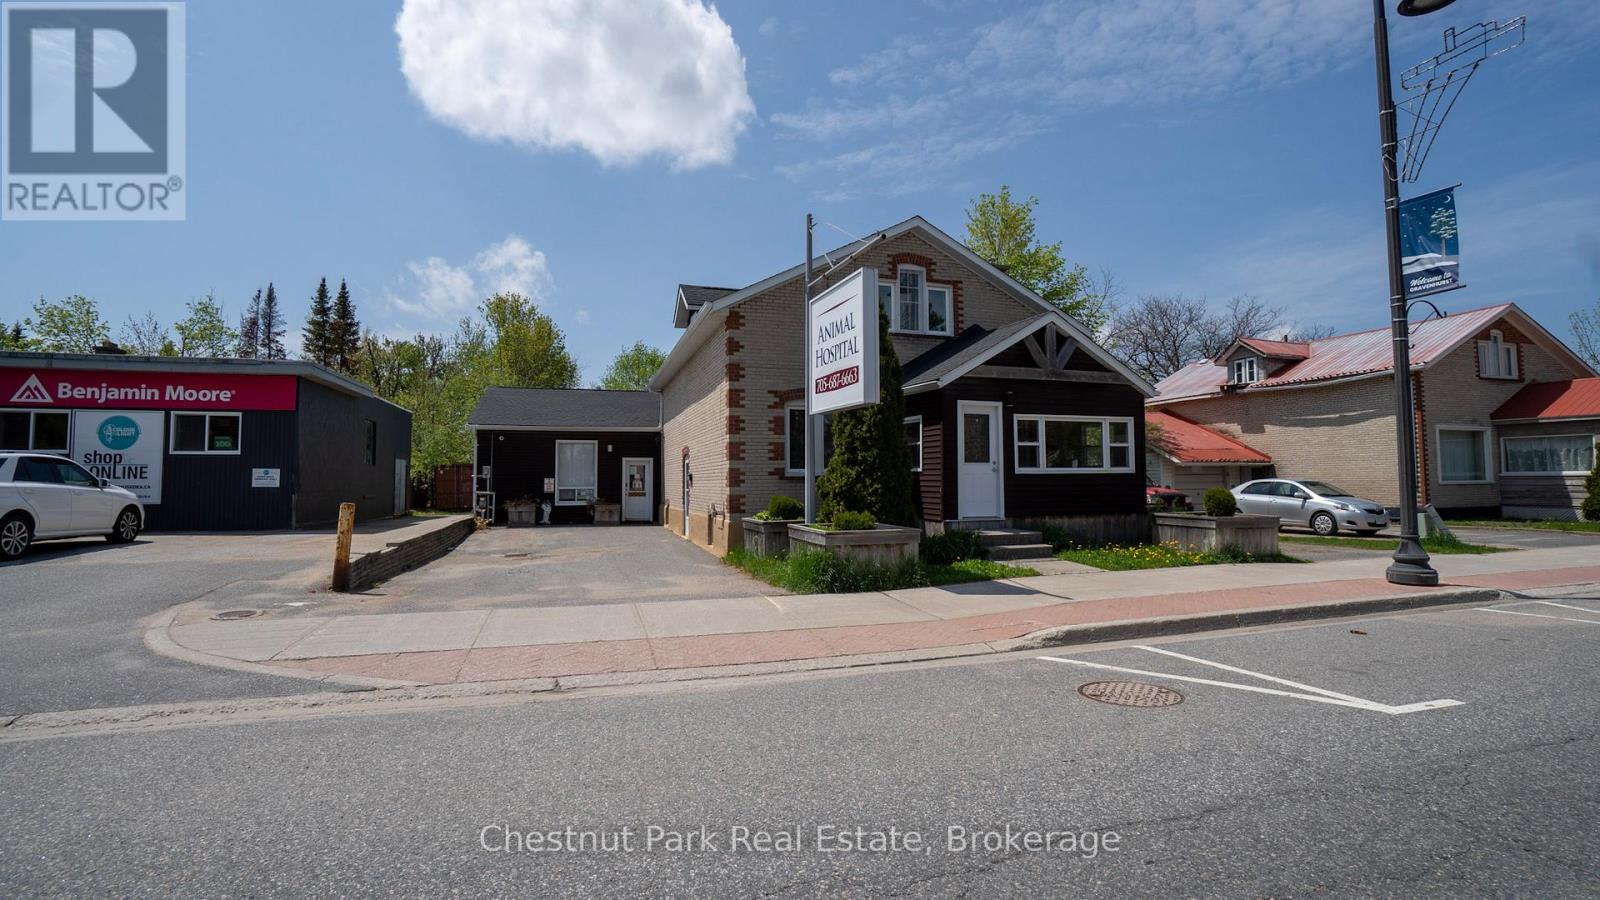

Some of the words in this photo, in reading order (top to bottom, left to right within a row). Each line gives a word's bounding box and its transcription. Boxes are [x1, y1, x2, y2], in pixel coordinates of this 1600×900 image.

[1410, 275, 1442, 287] Welcome
[1443, 271, 1452, 279] to
[1410, 278, 1453, 292] GRAVENHURST
[818, 312, 856, 345] ANIMAL
[816, 336, 859, 368] HOSPITAL
[57, 382, 160, 403] Benjamin
[84, 450, 123, 465] shop
[89, 465, 148, 479] ONLINE
